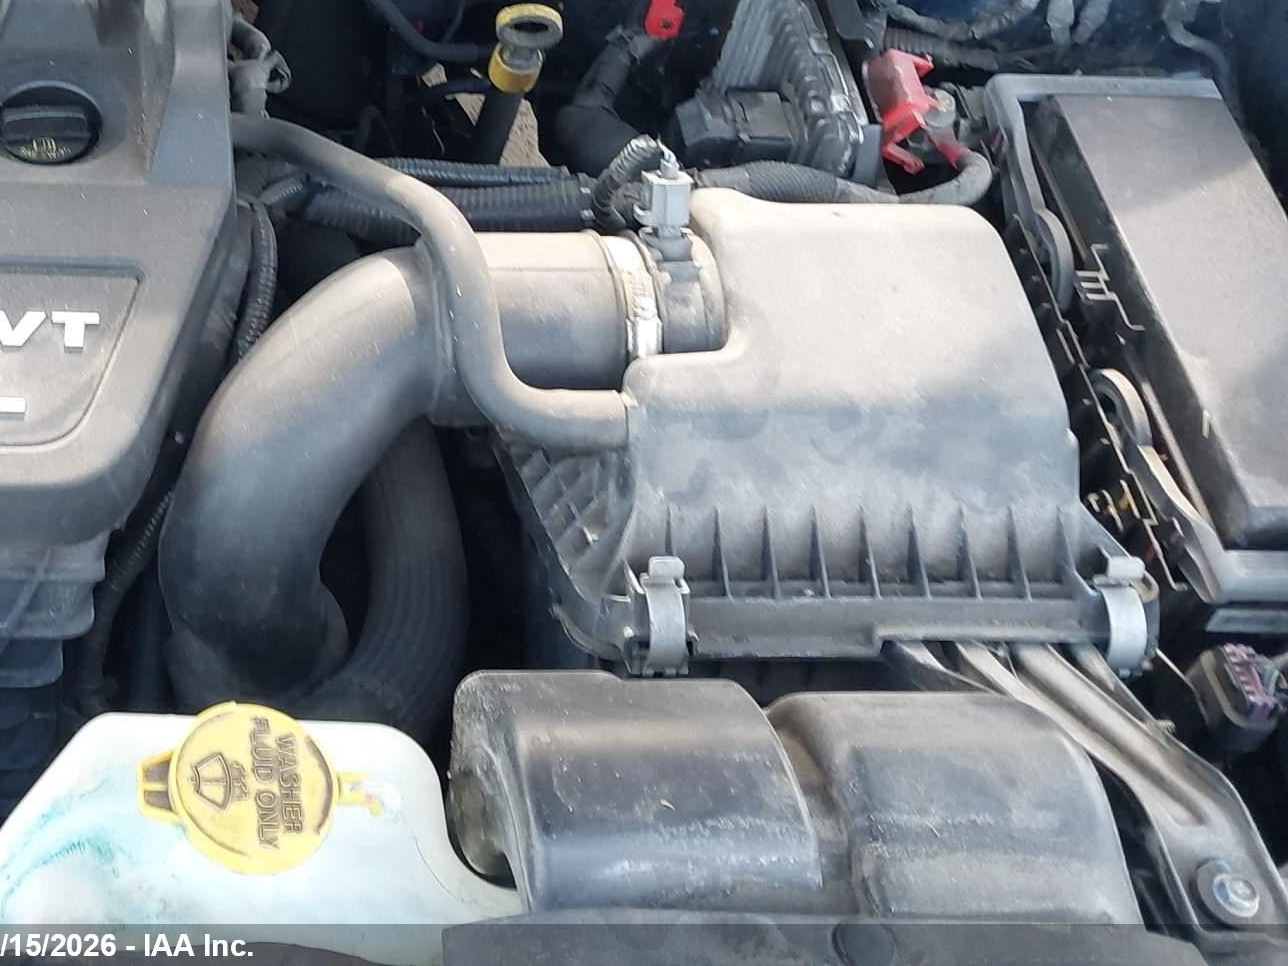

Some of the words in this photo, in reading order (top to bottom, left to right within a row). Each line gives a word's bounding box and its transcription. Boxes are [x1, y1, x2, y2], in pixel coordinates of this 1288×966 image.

[249, 716, 275, 785] FLUID
[275, 732, 304, 836] WASHER
[254, 788, 280, 851] ONLY
